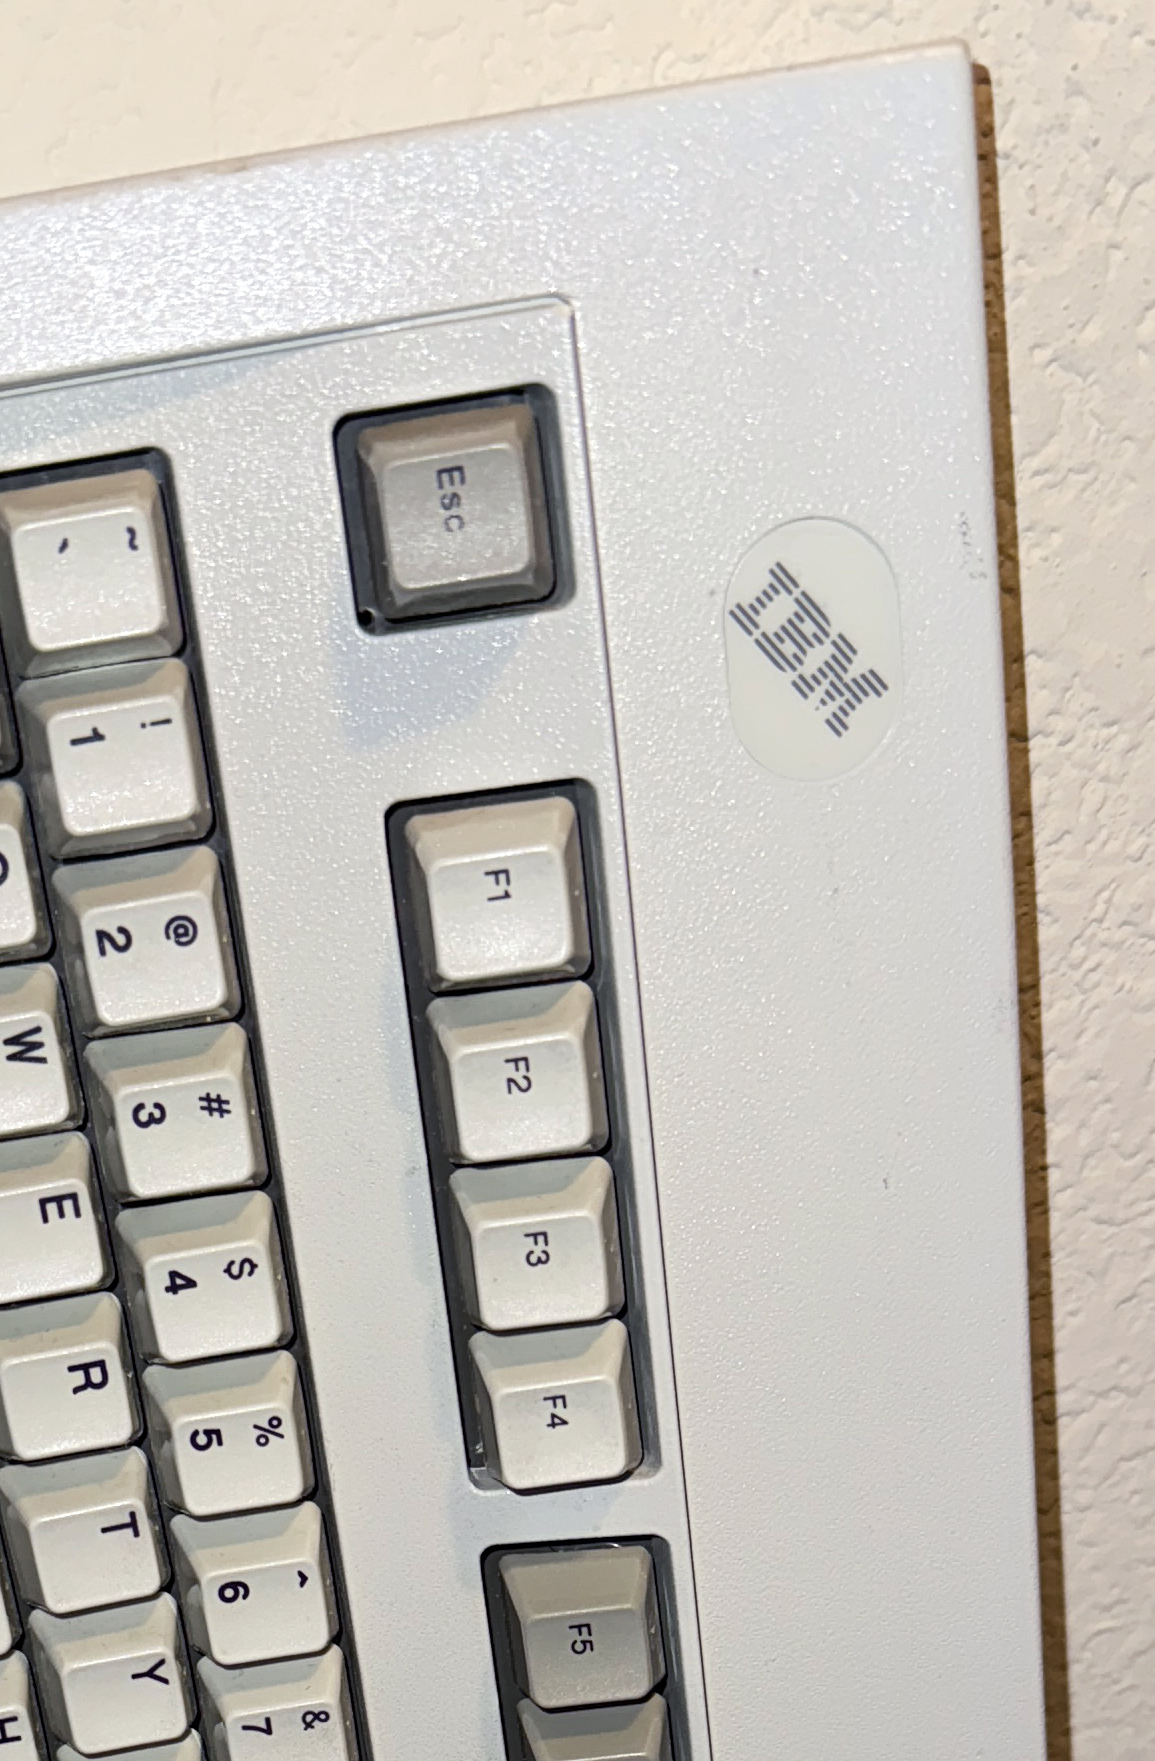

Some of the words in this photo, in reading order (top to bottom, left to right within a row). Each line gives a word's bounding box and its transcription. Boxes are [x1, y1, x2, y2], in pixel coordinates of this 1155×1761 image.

[436, 465, 467, 534] Esc
[729, 561, 889, 738] IBM
[70, 727, 106, 747] 1
[484, 867, 512, 902] F1
[95, 925, 132, 958] 2
[164, 915, 199, 948] @
[3, 1026, 49, 1064] W
[504, 1056, 532, 1095] F2
[132, 1101, 166, 1129] 3
[198, 1093, 232, 1119] #
[38, 1192, 82, 1224] E
[523, 1231, 550, 1267] F3
[164, 1270, 198, 1296] 4
[223, 1257, 259, 1281] $
[67, 1358, 110, 1395] R
[543, 1394, 569, 1430] F4
[189, 1429, 224, 1452] 5
[253, 1416, 286, 1448] %
[101, 1511, 140, 1538] T
[217, 1580, 250, 1604] 6
[569, 1622, 595, 1655] F5
[131, 1658, 170, 1685] Y
[241, 1716, 273, 1736] 7
[301, 1709, 331, 1731] &
